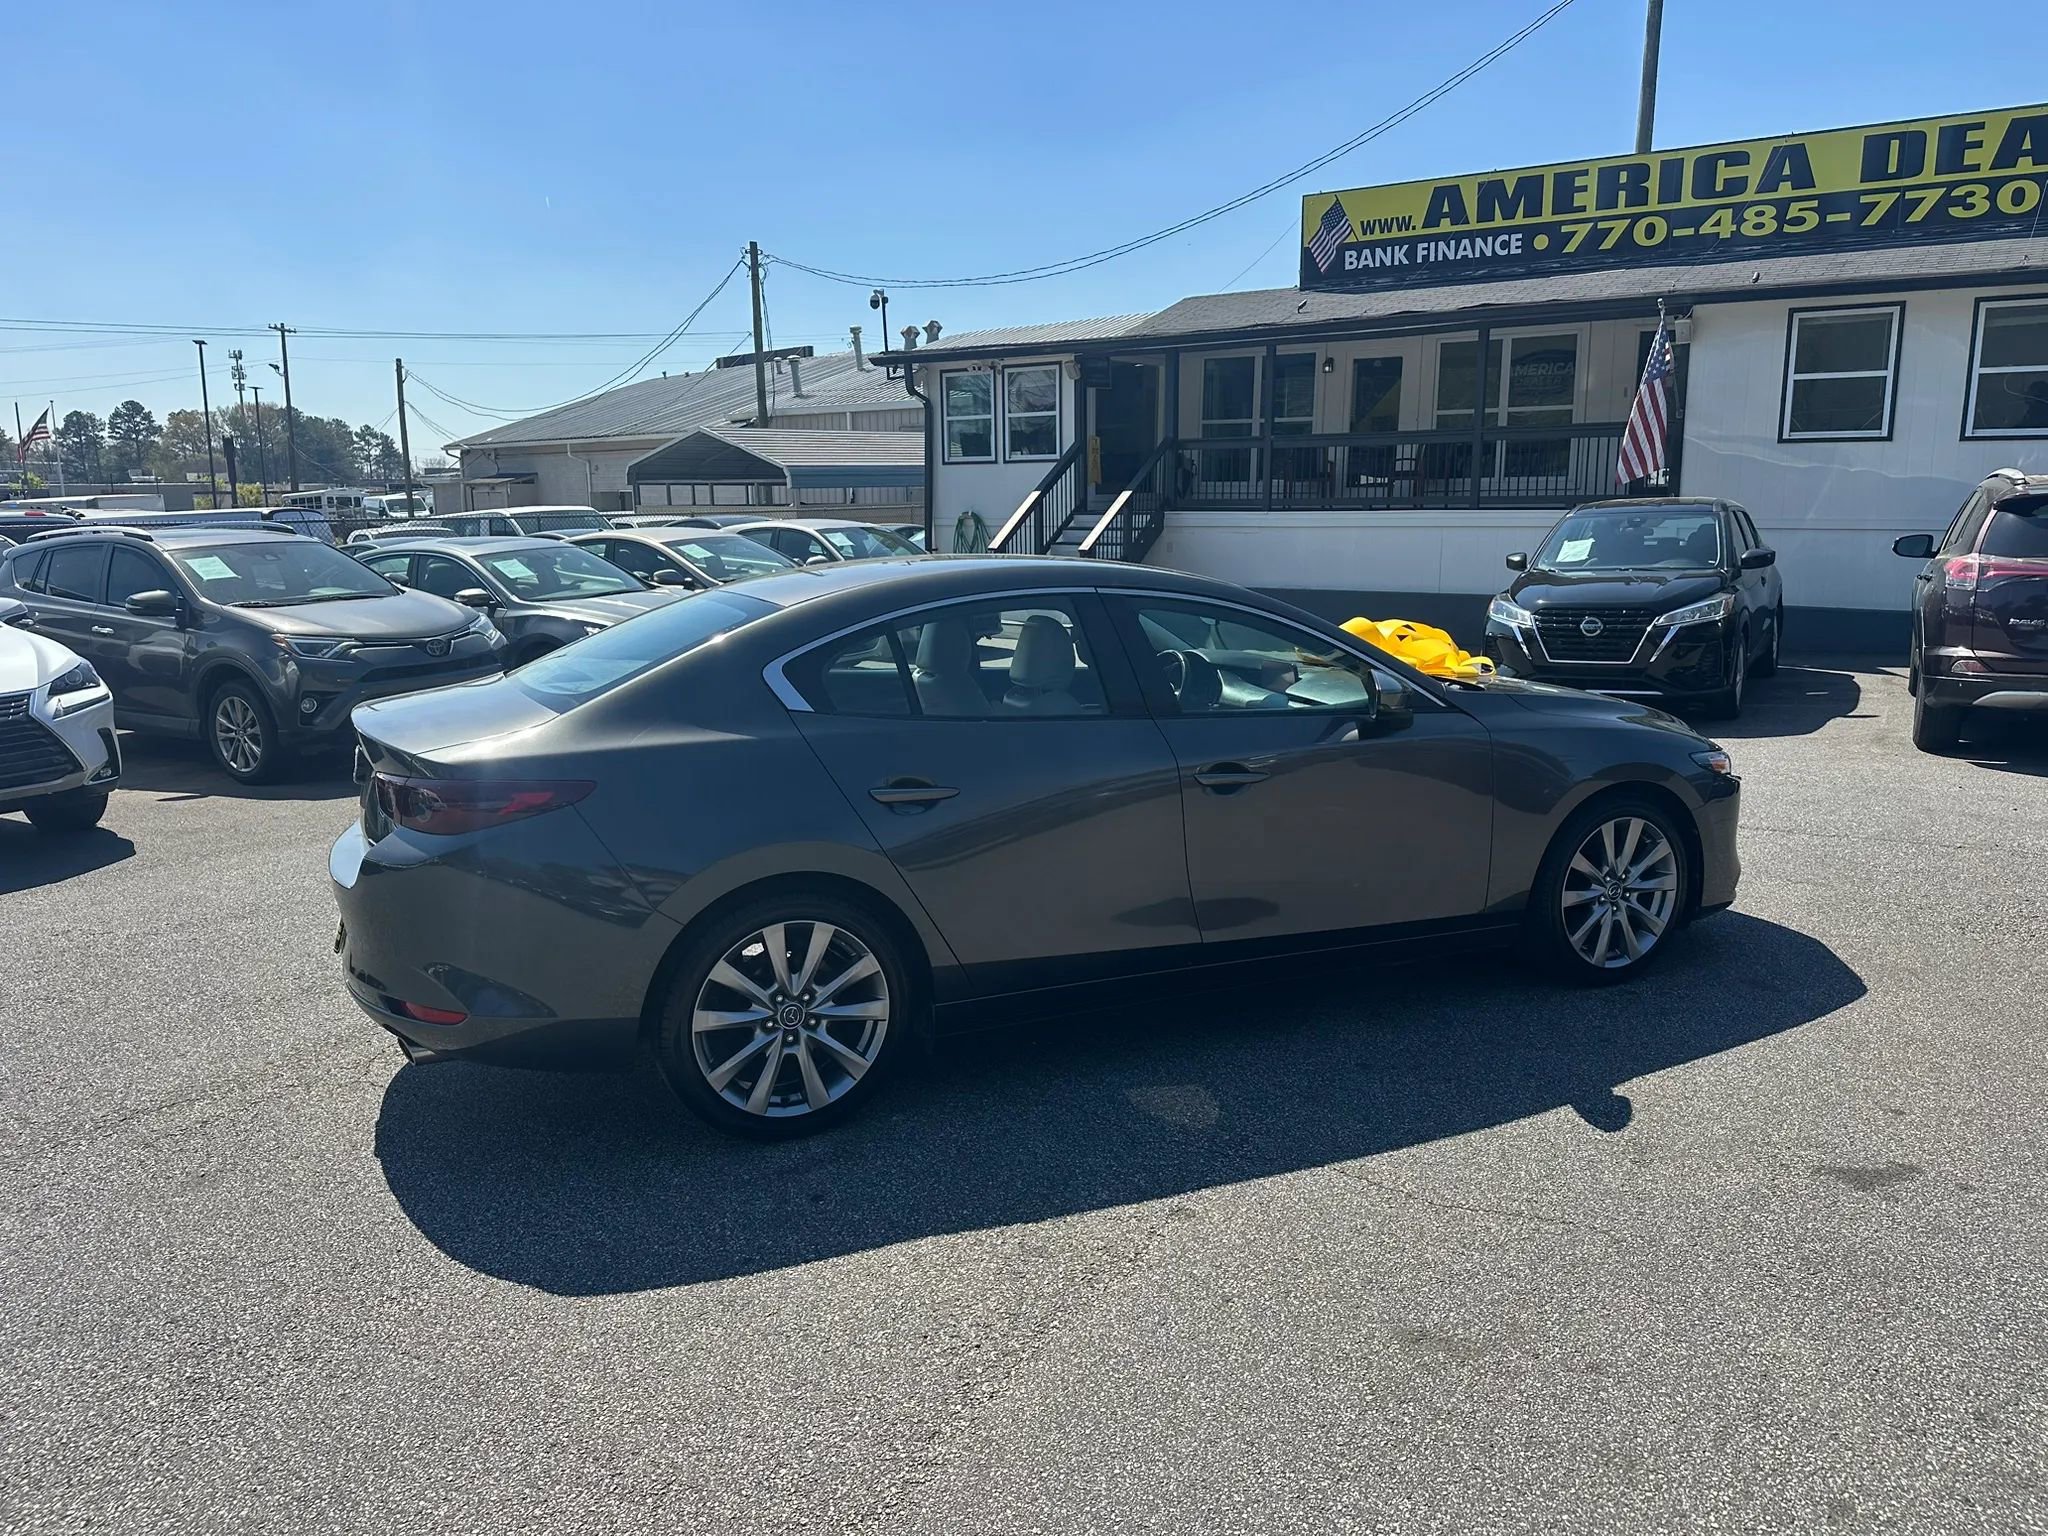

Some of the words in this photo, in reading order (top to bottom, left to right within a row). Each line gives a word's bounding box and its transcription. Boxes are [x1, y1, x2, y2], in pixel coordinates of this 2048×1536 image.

[1344, 244, 1409, 271] BANK
[1416, 233, 1523, 264] FINANCE
[1560, 179, 2041, 254] 770-485-7730
[1360, 214, 1416, 236] www.
[1421, 143, 1817, 229] AMERICA
[1860, 114, 2048, 183] DEA
